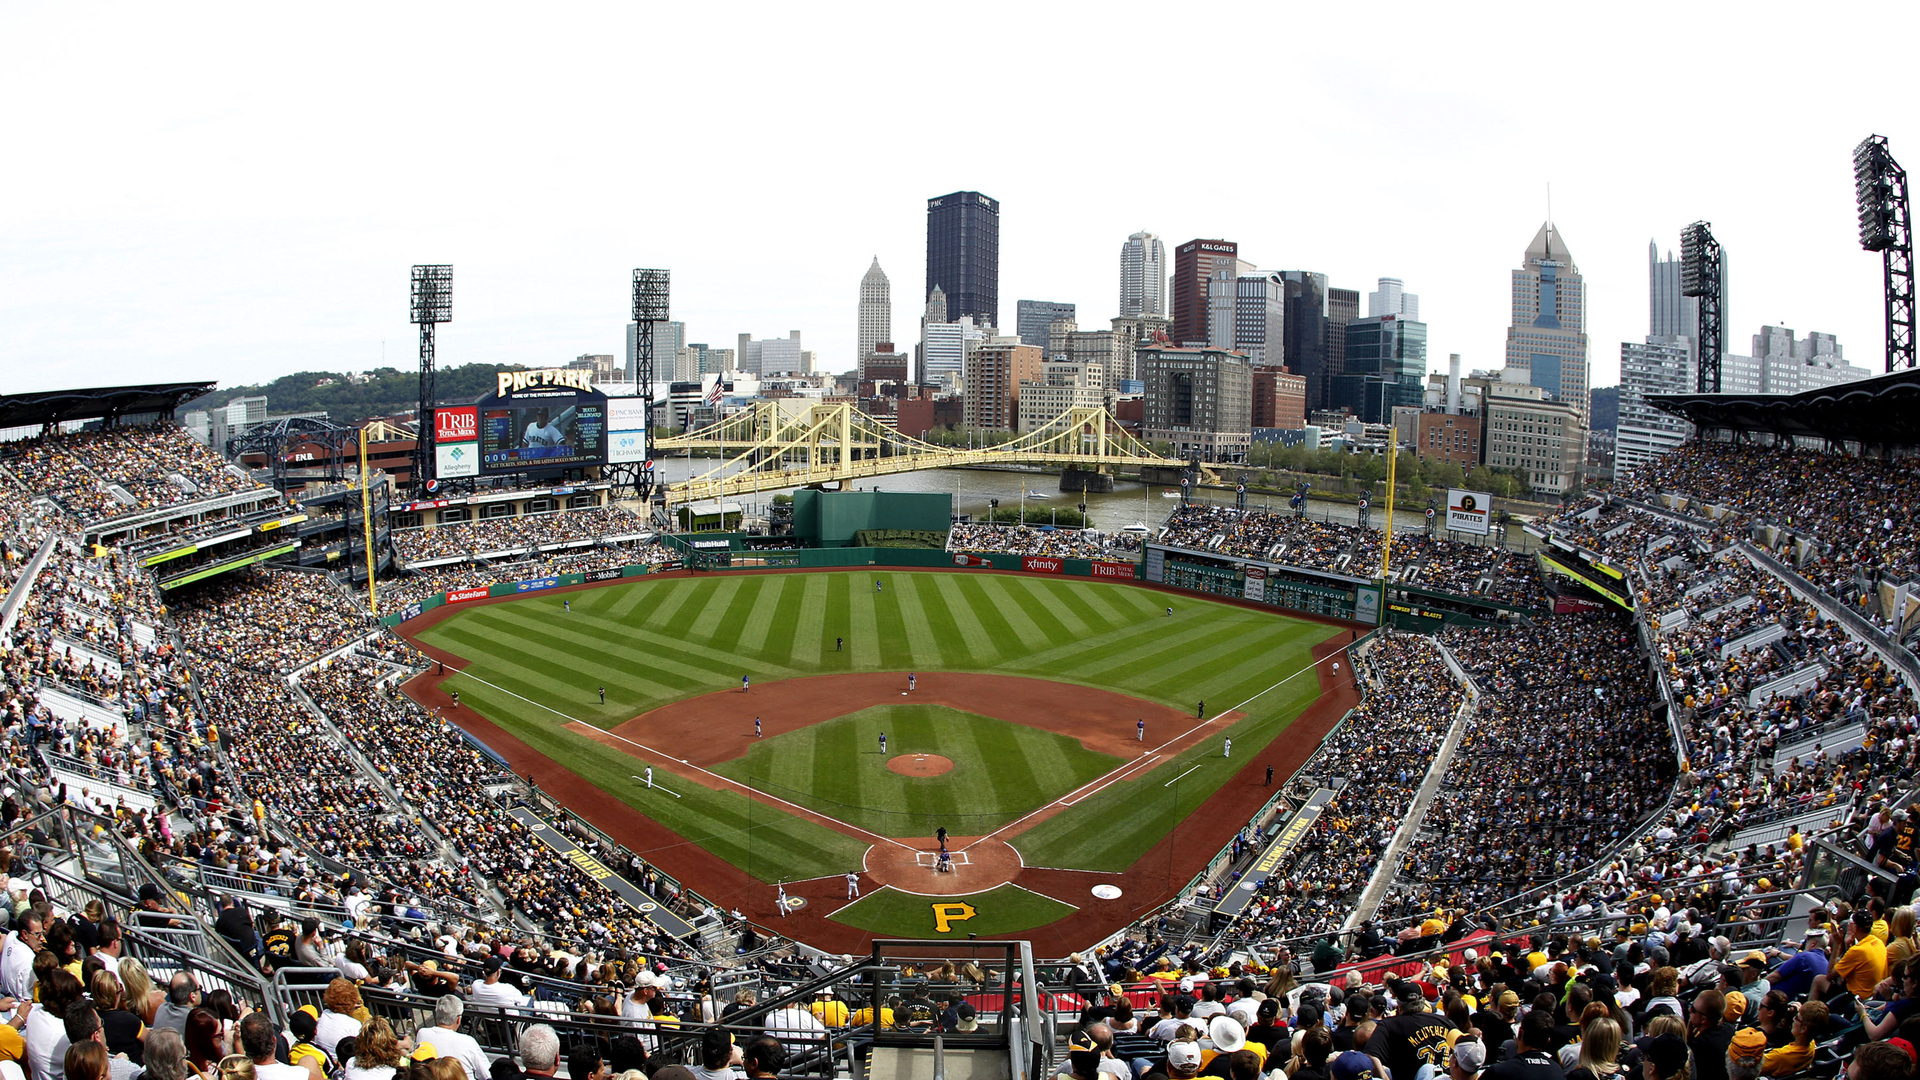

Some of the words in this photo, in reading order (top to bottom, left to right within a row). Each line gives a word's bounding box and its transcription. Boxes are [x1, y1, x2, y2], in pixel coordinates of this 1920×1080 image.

[979, 196, 991, 207] UPMC
[1214, 244, 1234, 252] GATES
[498, 372, 538, 398] PNC
[541, 369, 594, 393] PARK
[438, 412, 475, 429] TRIB
[438, 430, 458, 438] TOTAL
[458, 428, 476, 436] MEDIA
[444, 464, 471, 472] Allegheny
[1465, 498, 1472, 508] P
[1452, 512, 1482, 522] PIRATES
[1027, 559, 1058, 572] xfinity
[1092, 564, 1116, 576] TRIB
[1172, 565, 1206, 574] NATIONAL
[1208, 571, 1234, 580] LEAGUE
[1274, 584, 1313, 594] AMERICAN
[1315, 591, 1345, 601] LEAGUE
[1390, 604, 1411, 613] BOWSER
[1422, 611, 1443, 620] BLASTS
[1256, 846, 1287, 872] WELCOME
[1282, 828, 1301, 841] PNC
[1292, 817, 1310, 830] PARK
[1896, 834, 1911, 850] 22
[565, 849, 612, 880] PIRATES
[930, 900, 980, 933] P
